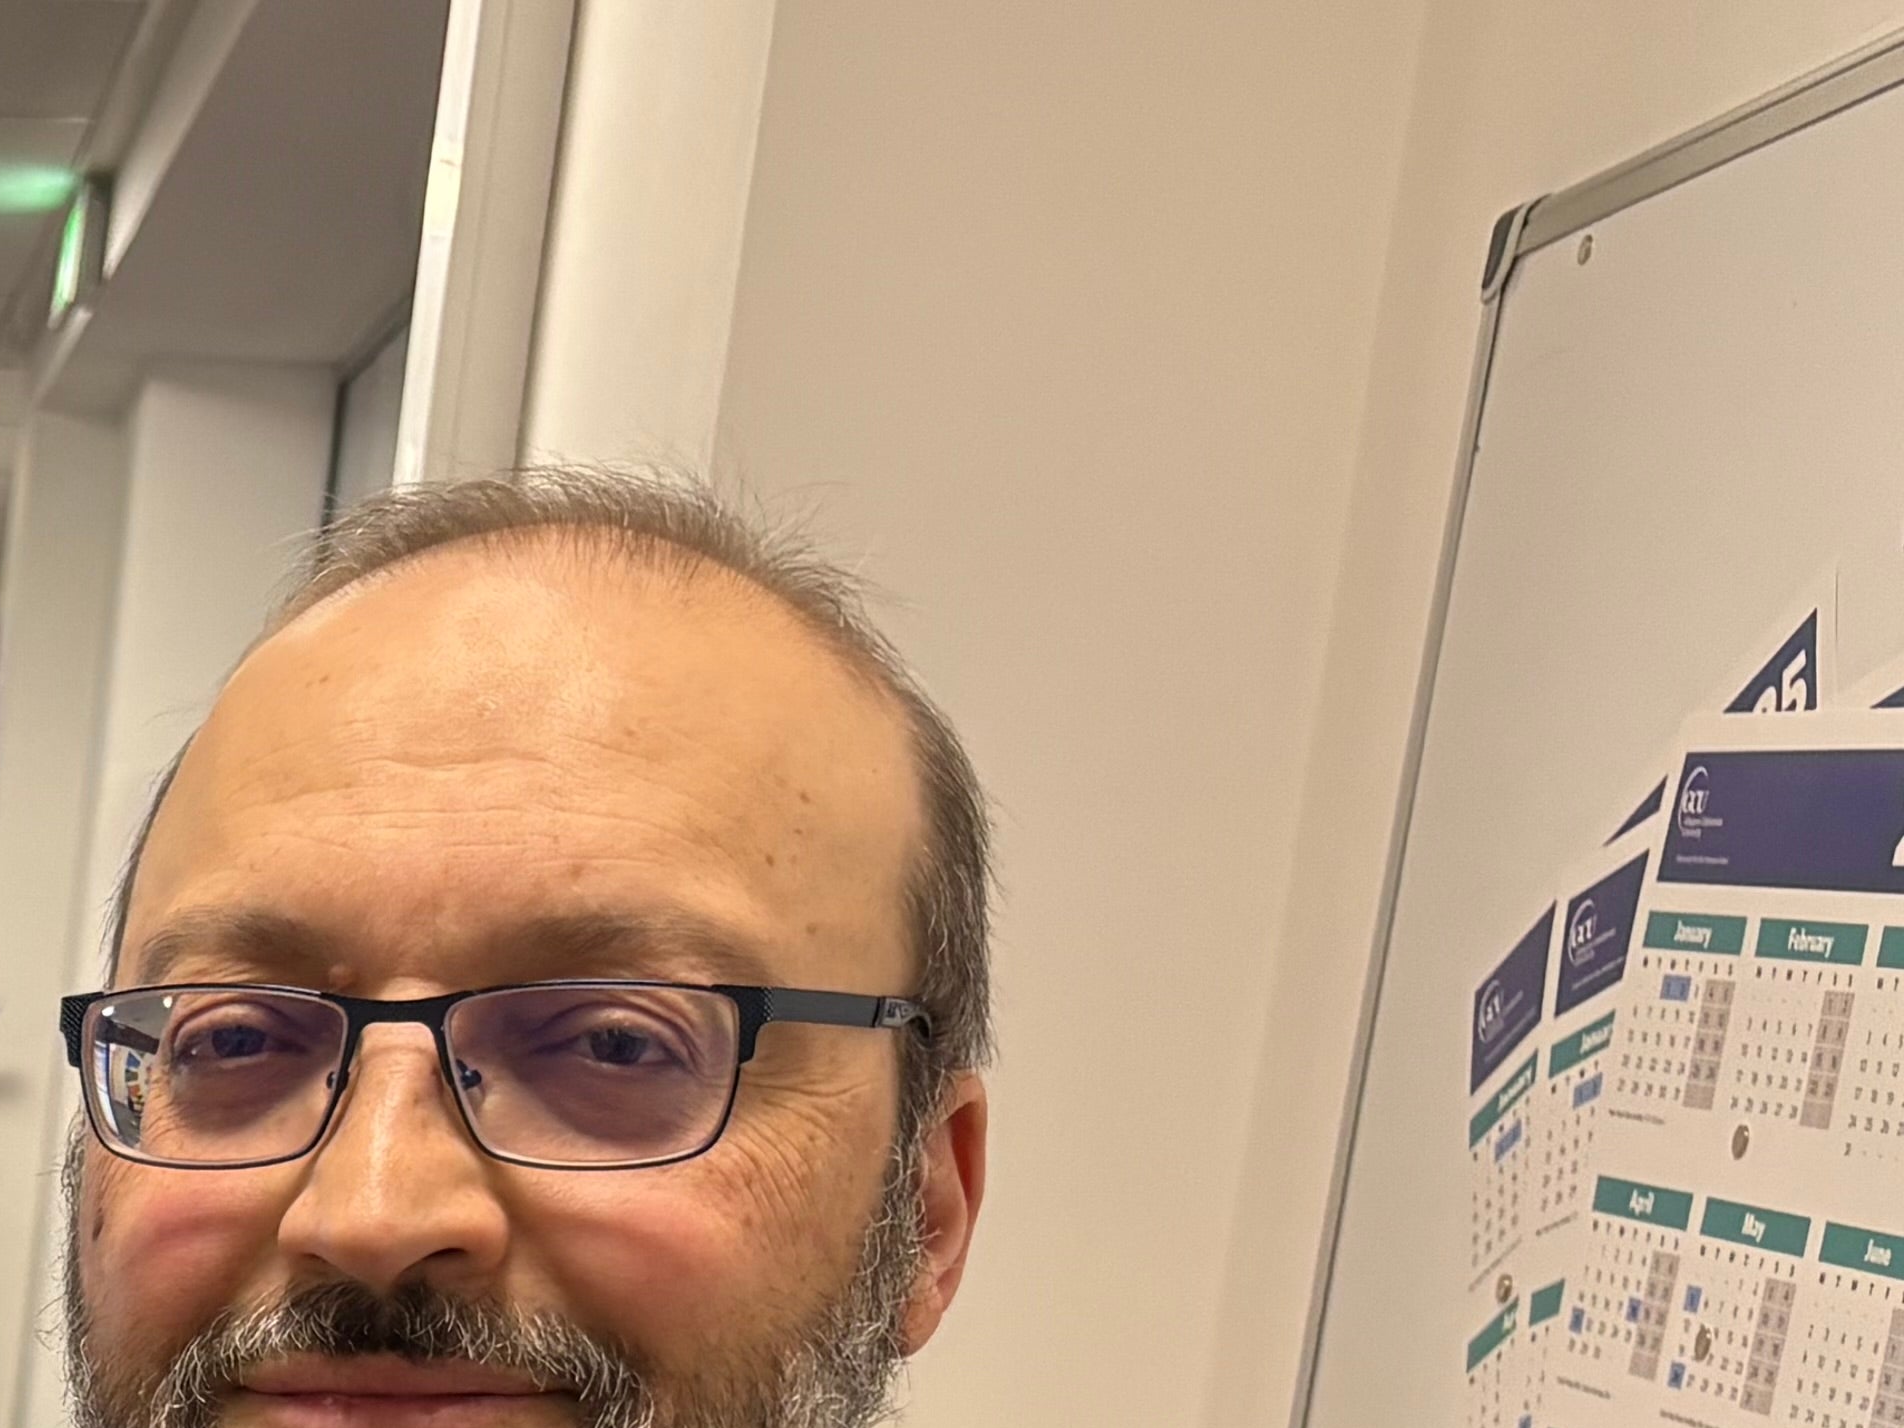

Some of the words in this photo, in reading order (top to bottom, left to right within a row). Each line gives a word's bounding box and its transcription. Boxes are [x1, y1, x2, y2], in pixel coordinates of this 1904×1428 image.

[1674, 920, 1712, 949] January
[1788, 927, 1834, 958] February
[1741, 1212, 1766, 1243] May
[1864, 1238, 1892, 1267] June
